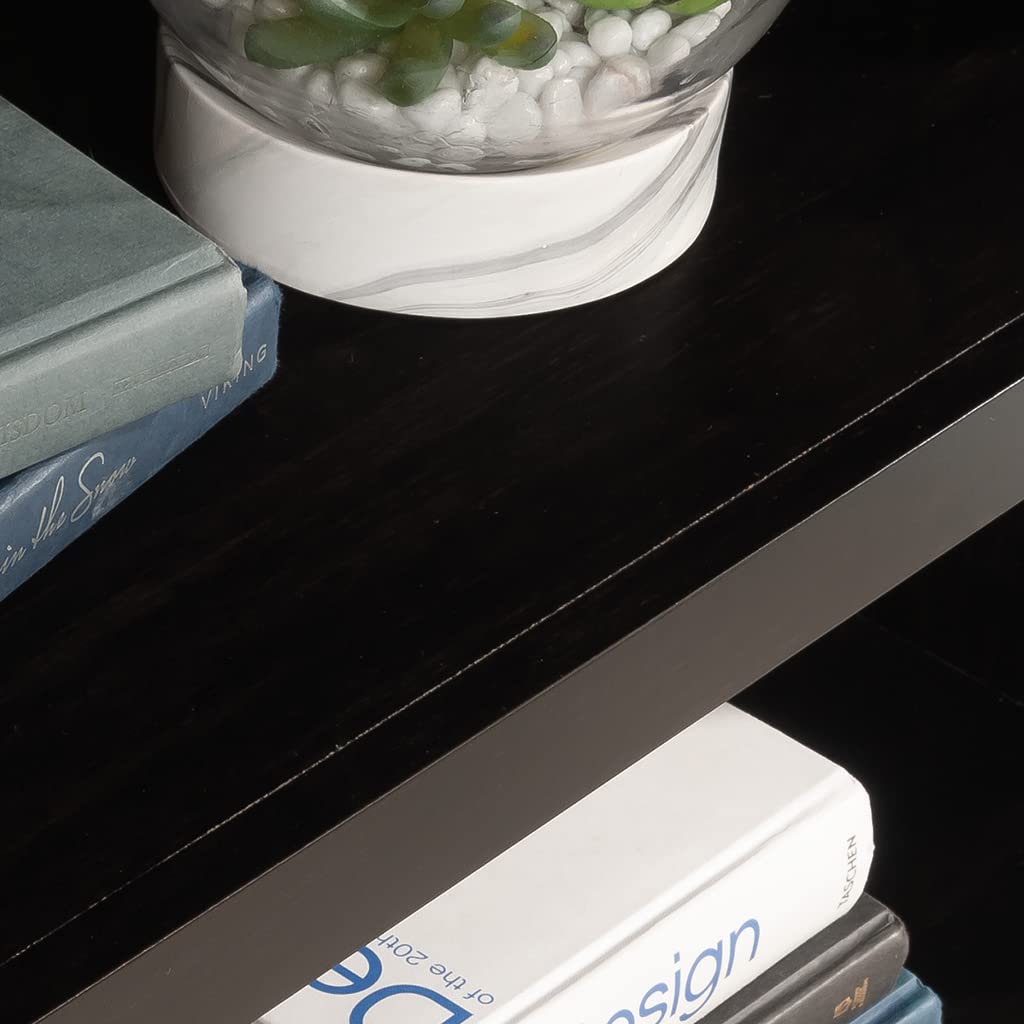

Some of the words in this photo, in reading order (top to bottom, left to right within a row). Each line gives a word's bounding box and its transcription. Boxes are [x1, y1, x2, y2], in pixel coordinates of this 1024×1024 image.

[0, 545, 26, 574] in
[32, 475, 67, 549] the
[70, 451, 137, 523] Snow
[837, 834, 857, 909] TASCHEN
[429, 962, 467, 990] the
[462, 988, 495, 1006] of
